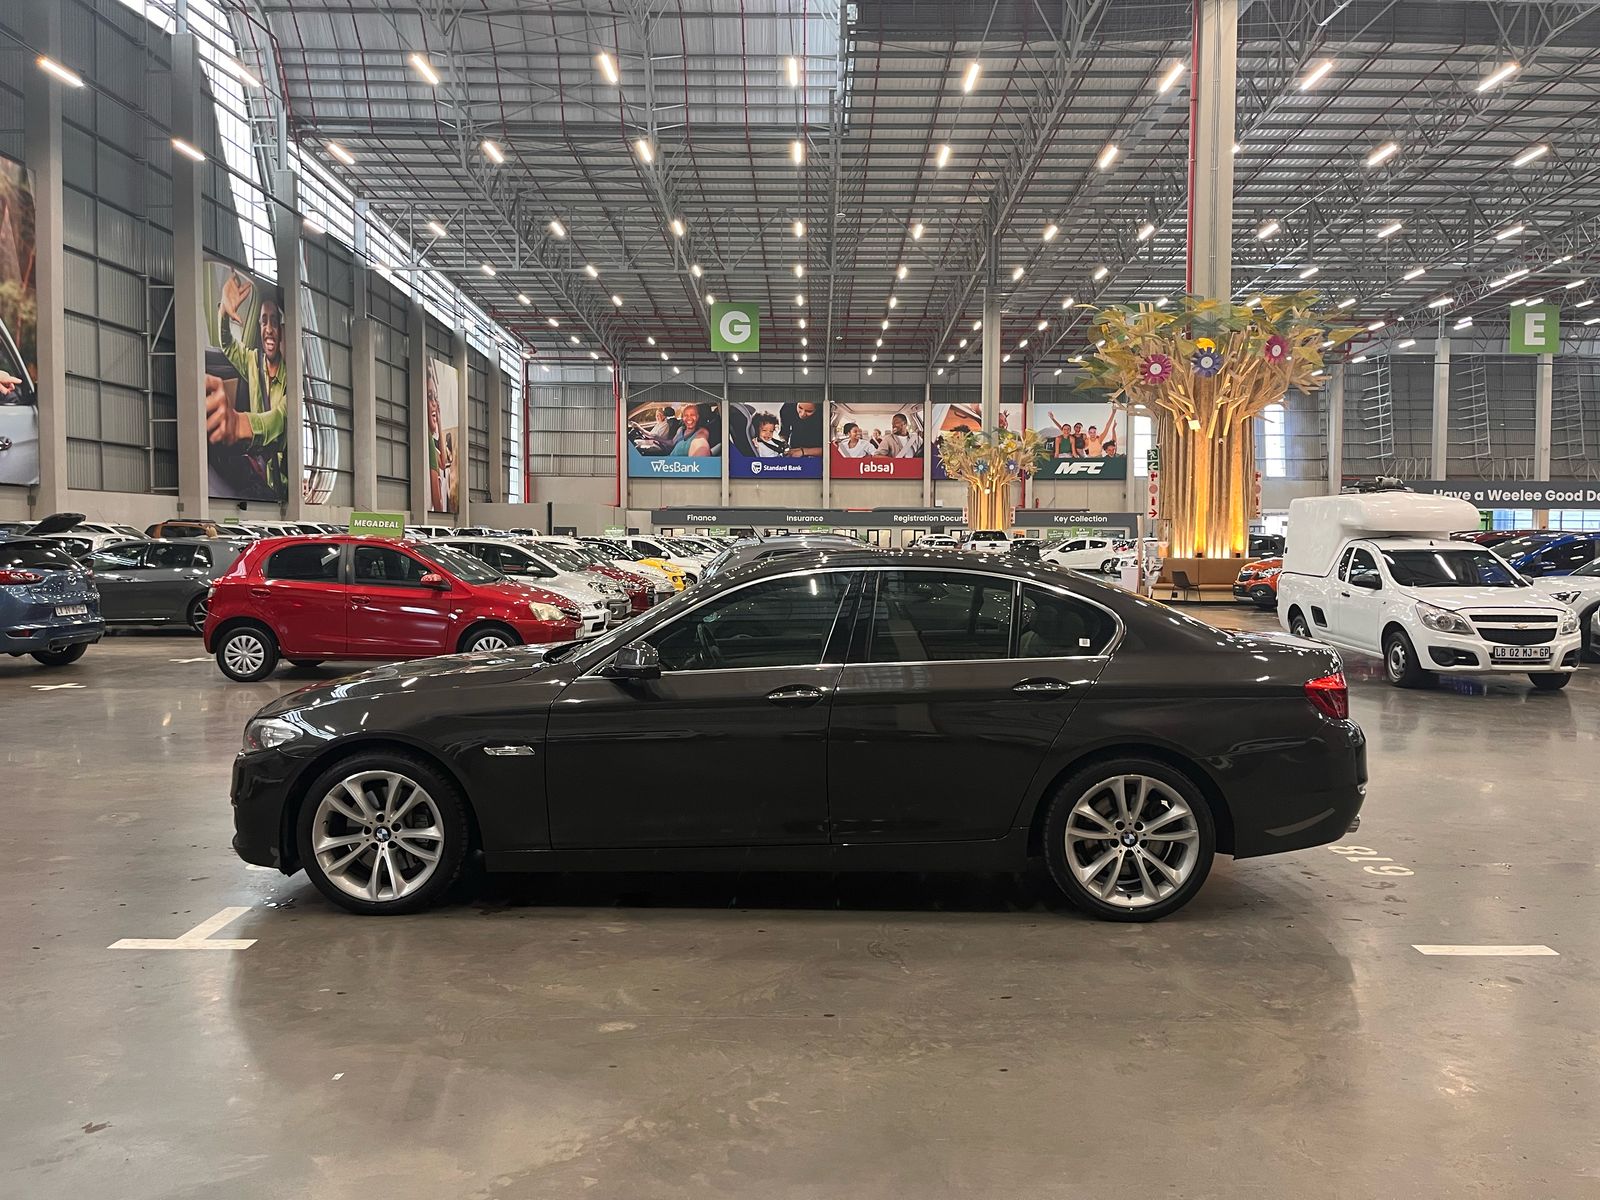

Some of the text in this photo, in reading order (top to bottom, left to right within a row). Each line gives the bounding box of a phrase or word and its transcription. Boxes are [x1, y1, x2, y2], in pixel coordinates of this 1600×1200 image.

[720, 310, 751, 344] G
[1524, 312, 1546, 346] E
[651, 460, 700, 473] WesBank
[859, 462, 894, 474] (absa)
[1054, 461, 1105, 474] MFC
[1474, 491, 1483, 501] a
[1488, 489, 1542, 501] Weelee
[1545, 489, 1584, 502] Good
[687, 514, 717, 522] Finance
[786, 514, 824, 522] Insurance
[893, 514, 939, 524] Registration
[1054, 515, 1108, 523] Key Collection
[353, 519, 400, 529] MEGADEAL
[1540, 648, 1549, 657] GP
